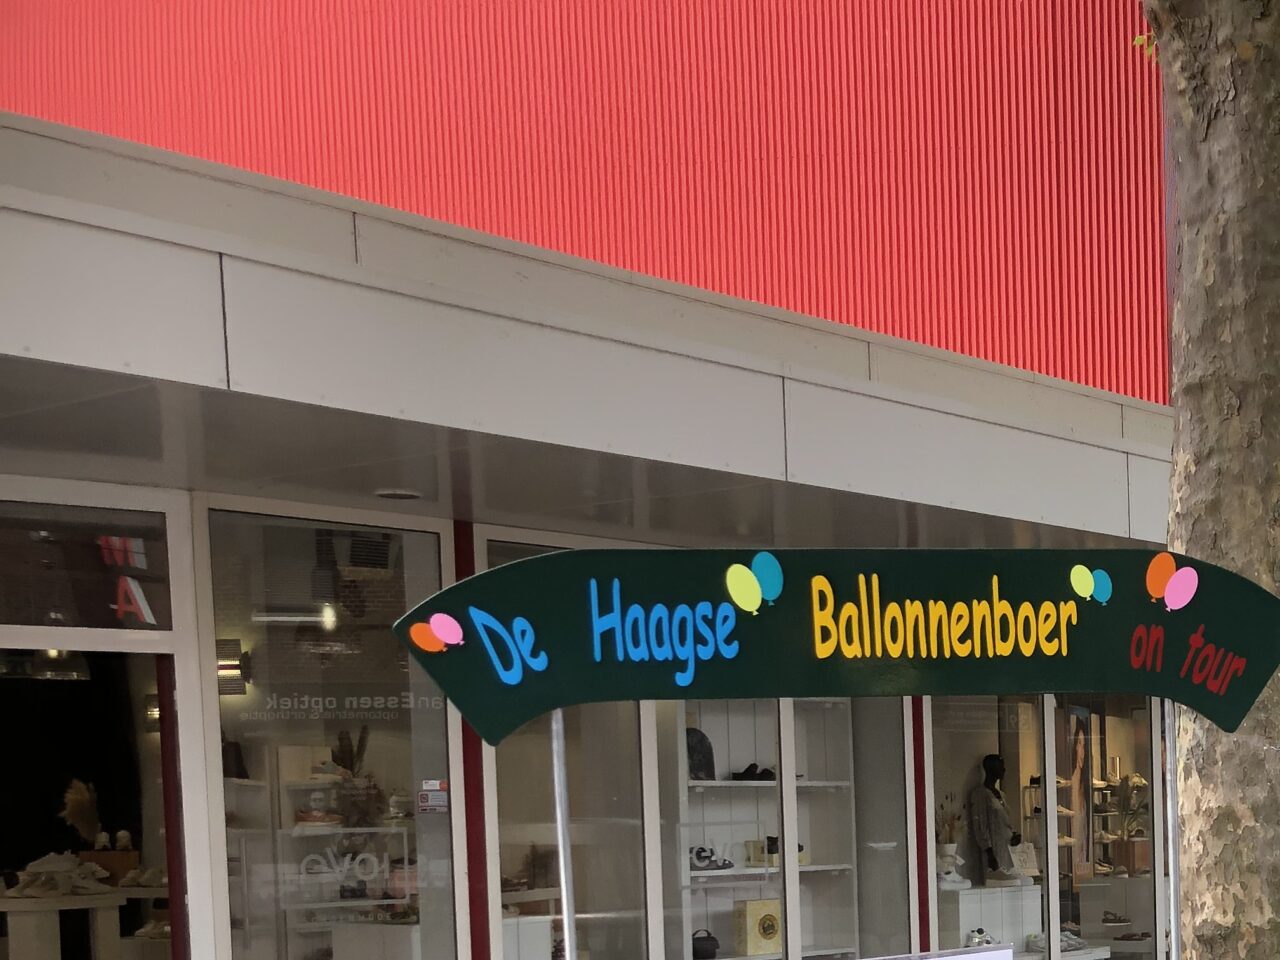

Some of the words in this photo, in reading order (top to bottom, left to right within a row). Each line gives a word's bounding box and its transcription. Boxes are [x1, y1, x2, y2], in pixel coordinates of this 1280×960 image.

[468, 606, 548, 686] De
[588, 577, 740, 687] Haagse
[810, 573, 1078, 660] Ballonnenboer
[1130, 623, 1164, 673] on
[1180, 623, 1248, 697] tour
